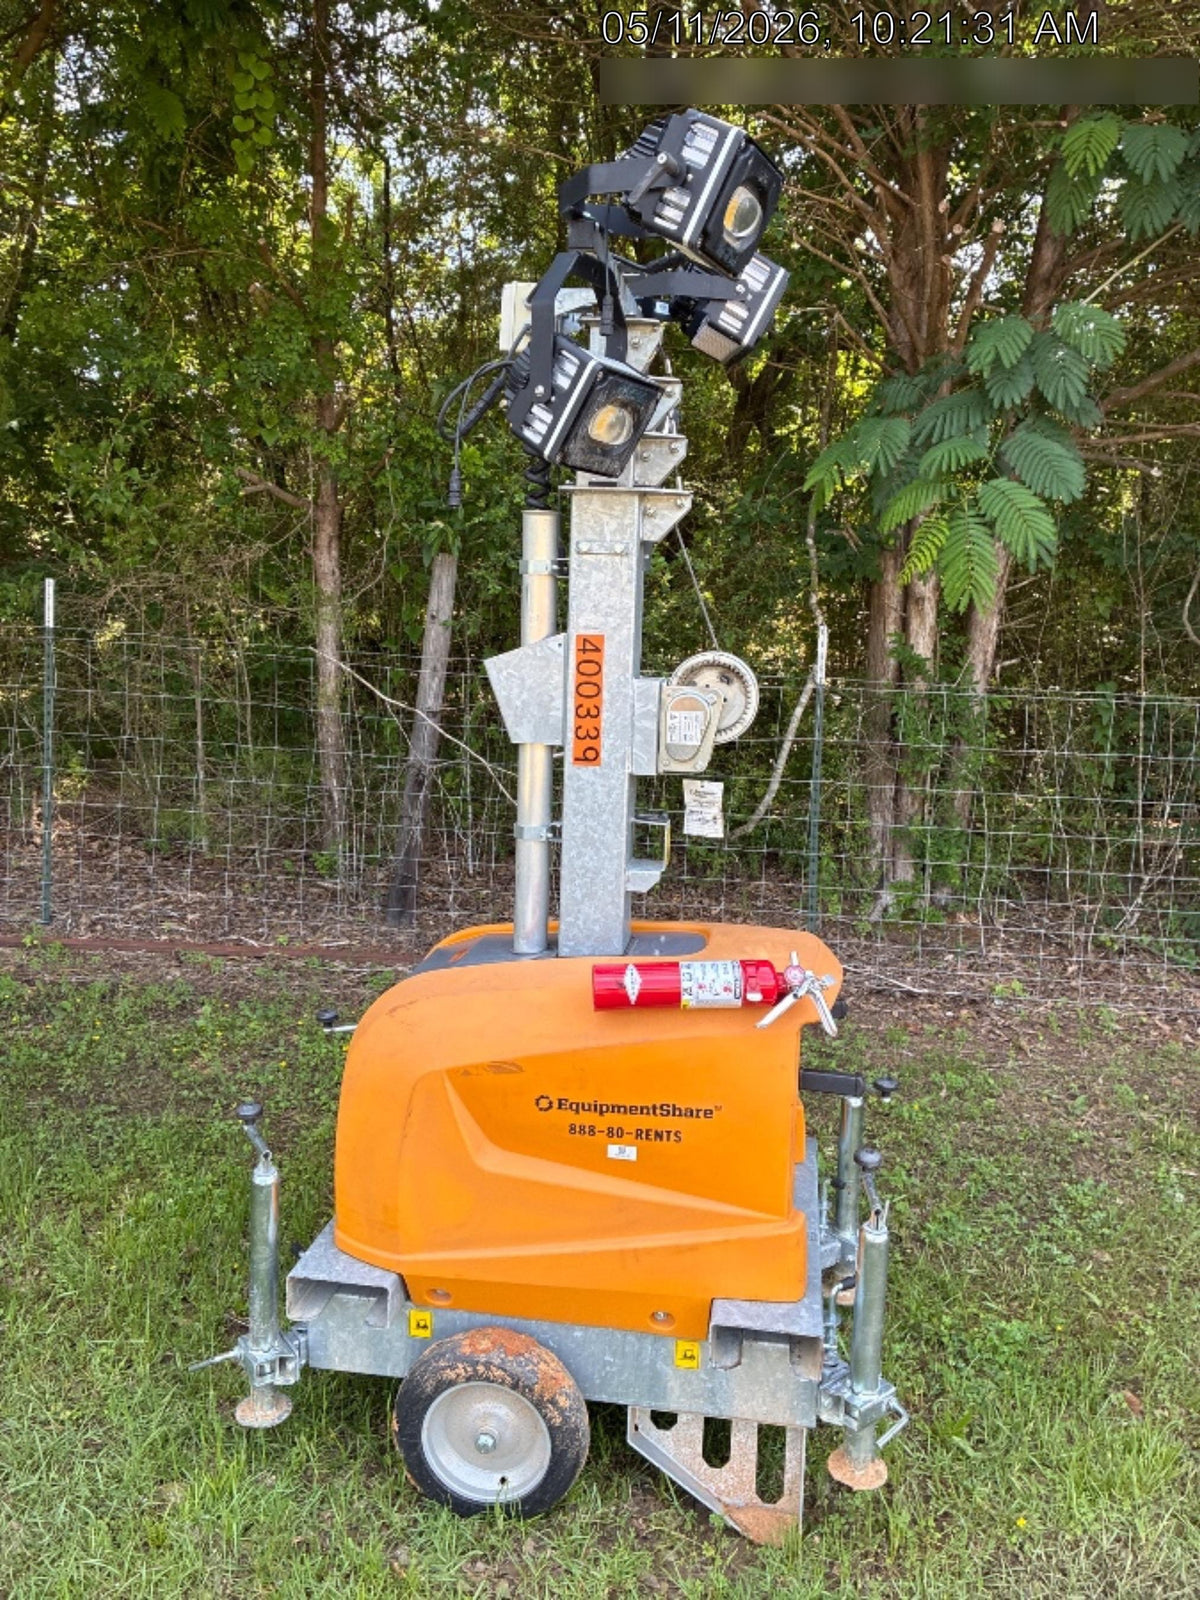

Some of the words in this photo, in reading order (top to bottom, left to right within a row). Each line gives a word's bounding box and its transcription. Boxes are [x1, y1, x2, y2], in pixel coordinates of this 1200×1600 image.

[574, 637, 602, 763] 400339
[556, 1097, 715, 1119] EquipmentShare
[568, 1123, 683, 1143] 888-80-RENTS
